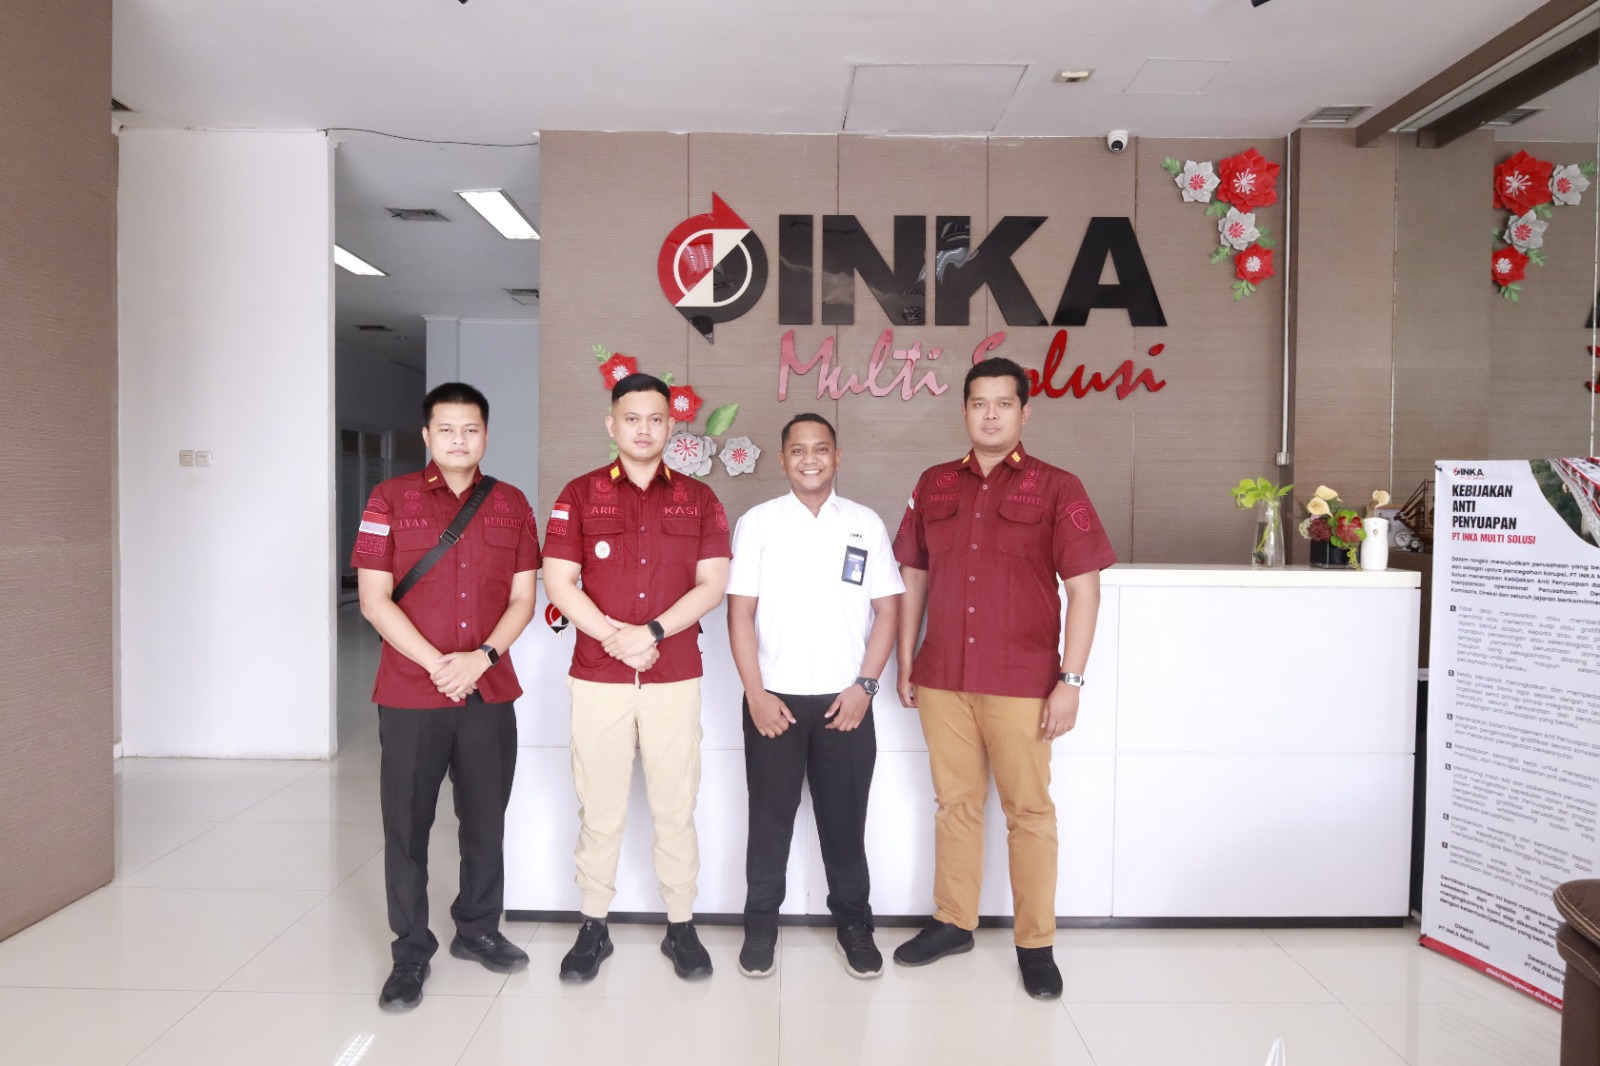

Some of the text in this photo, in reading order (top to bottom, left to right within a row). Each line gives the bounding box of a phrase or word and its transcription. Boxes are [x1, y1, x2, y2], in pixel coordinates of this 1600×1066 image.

[778, 214, 1168, 327] INKA
[778, 327, 949, 403] Multi
[1460, 468, 1484, 477] INKA
[1452, 484, 1513, 498] KEBIJAKAN
[590, 506, 619, 515] ARIE
[664, 506, 698, 516] KASI
[1452, 500, 1475, 512] ANTI
[1452, 516, 1517, 530] PENYUAPAN
[1462, 533, 1478, 542] INKA
[1480, 534, 1504, 543] MULTI
[1507, 535, 1536, 544] SOLUSI
[1455, 923, 1474, 934] Direksi
[1446, 927, 1459, 937] INKA
[1460, 933, 1473, 943] Multi
[1475, 939, 1490, 950] Solusi
[1528, 954, 1547, 967] Dewan
[1532, 965, 1545, 976] INKA
[1547, 972, 1560, 983] Multi
